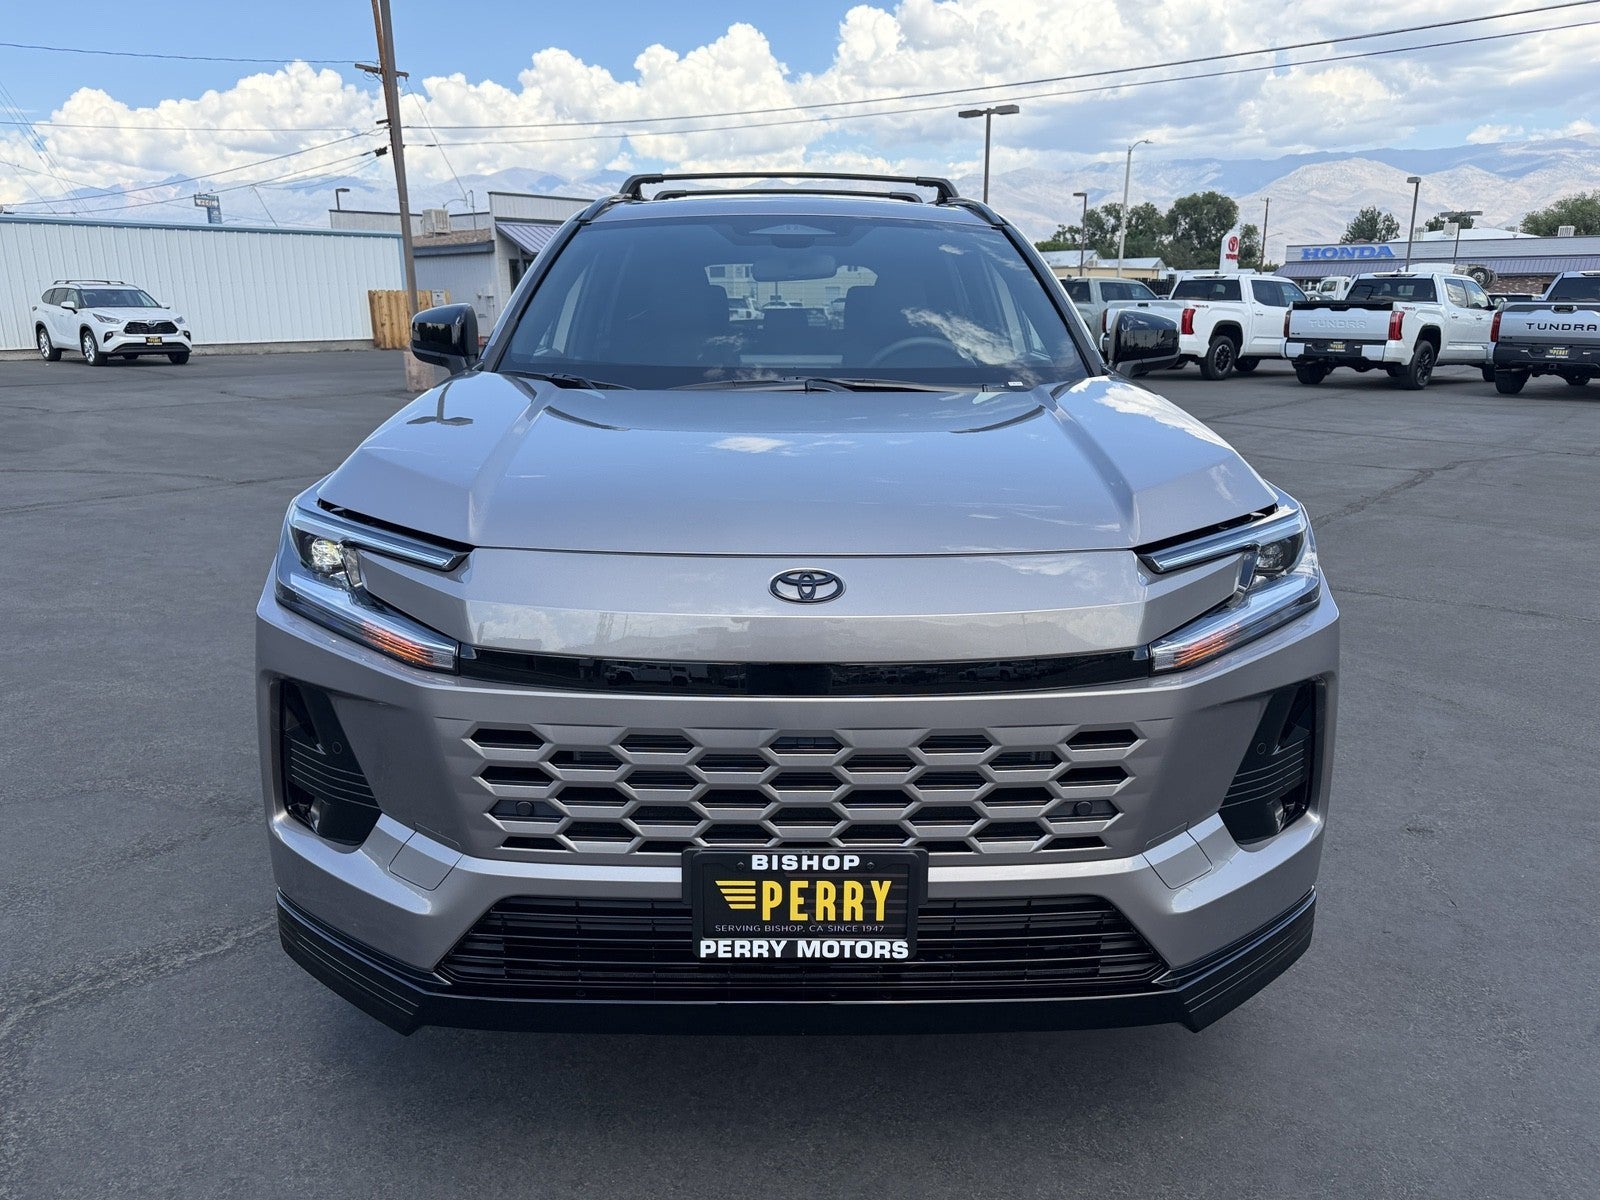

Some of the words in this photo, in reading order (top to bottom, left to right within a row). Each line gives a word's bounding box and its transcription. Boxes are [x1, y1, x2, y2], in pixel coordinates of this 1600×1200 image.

[1301, 245, 1395, 260] HONDA
[1309, 319, 1368, 329] TUNDRA
[1526, 322, 1598, 332] TUNDRA
[751, 854, 861, 871] BISHOP
[761, 880, 892, 922] PERRY
[715, 924, 761, 932] SERVING
[809, 924, 824, 932] CA
[827, 924, 858, 932] SINCE
[862, 924, 885, 932] 1947
[700, 940, 788, 958] PERRY
[797, 940, 909, 959] MOTORS
